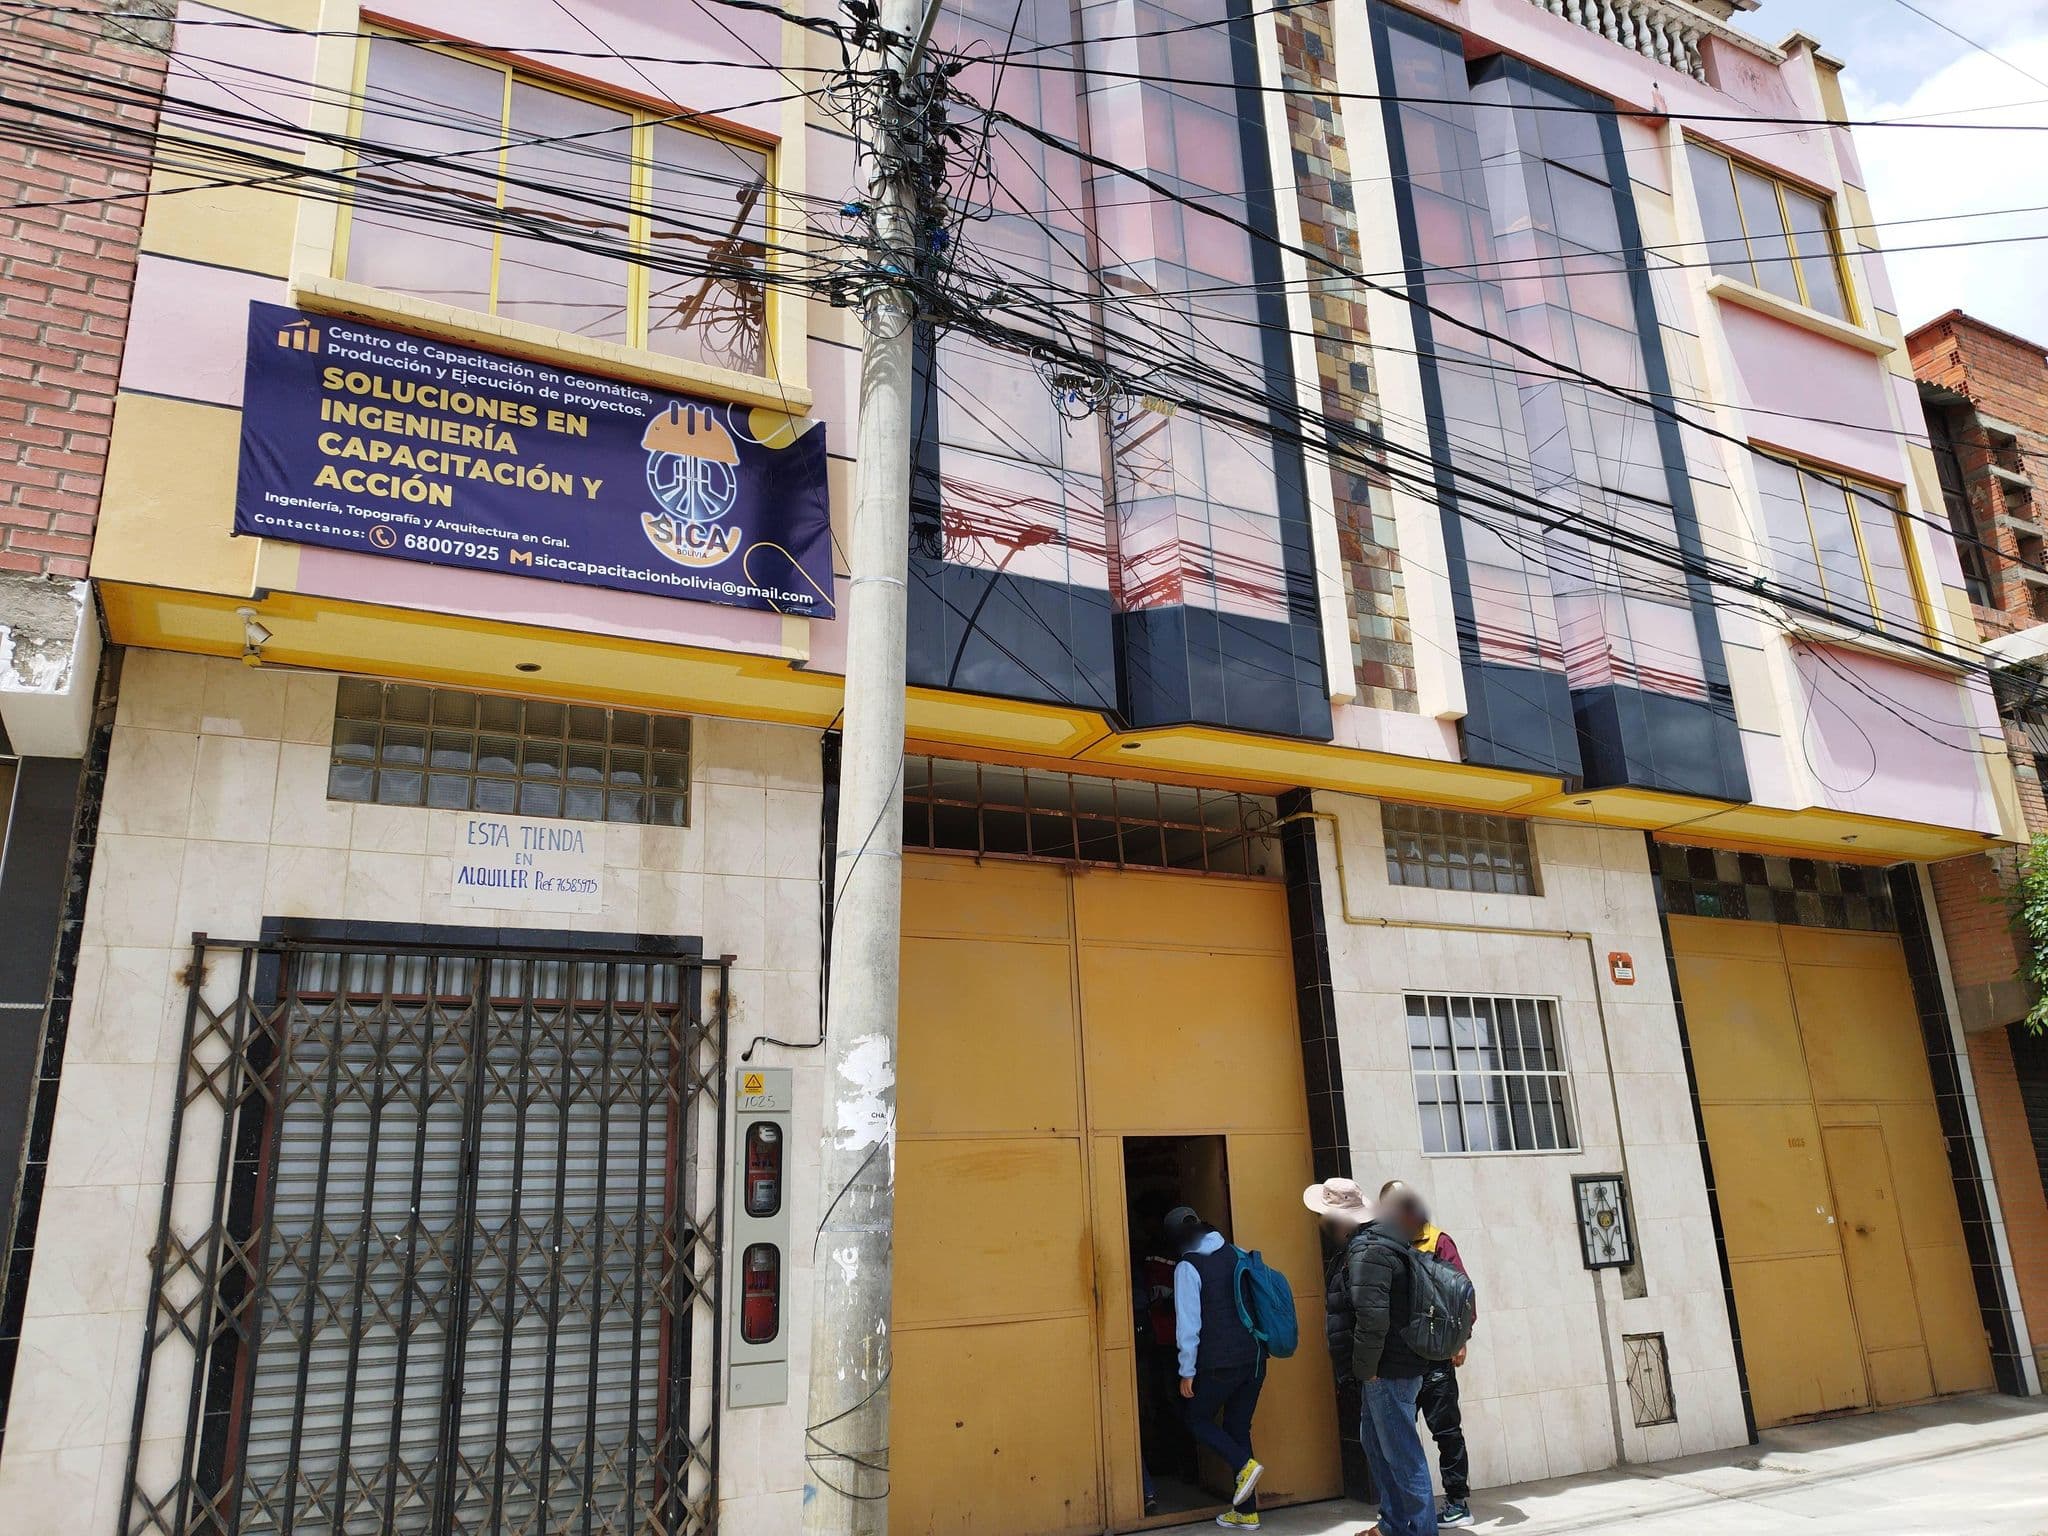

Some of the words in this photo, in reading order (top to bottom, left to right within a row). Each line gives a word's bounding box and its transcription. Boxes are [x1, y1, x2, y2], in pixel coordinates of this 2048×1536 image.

[328, 343, 431, 375] Producción
[436, 367, 447, 380] y
[452, 368, 534, 395] Ejecución
[539, 387, 560, 400] de
[564, 392, 646, 418] proyectos.
[329, 326, 391, 349] Centro
[396, 340, 419, 355] de
[423, 346, 535, 379] Capacitación
[539, 371, 559, 384] en
[564, 375, 653, 405] Geomática,
[320, 398, 518, 456] INGENIERÍA
[322, 366, 538, 428] SOLUCIONES
[547, 410, 588, 438] EN
[313, 464, 453, 508] ACCIÓN
[317, 431, 573, 497] CAPACITACIÓN
[581, 476, 604, 501] Y
[264, 492, 343, 515] Ingeniería,
[346, 504, 421, 526] Topografía
[424, 518, 433, 529] y
[435, 518, 519, 541] Arquitectura
[522, 533, 538, 544] en
[542, 535, 570, 549] Gral.
[647, 513, 730, 554] SICA
[254, 513, 366, 539] Contactanos:
[404, 533, 500, 561] 68007925
[535, 553, 814, 605] sicacapacitacionbolivia@gmail.com
[676, 548, 708, 559] BOLIVIA
[468, 820, 510, 848] ESTA
[520, 826, 584, 854] TIENDA
[514, 852, 533, 866] EN
[457, 866, 528, 890] ALQUILER
